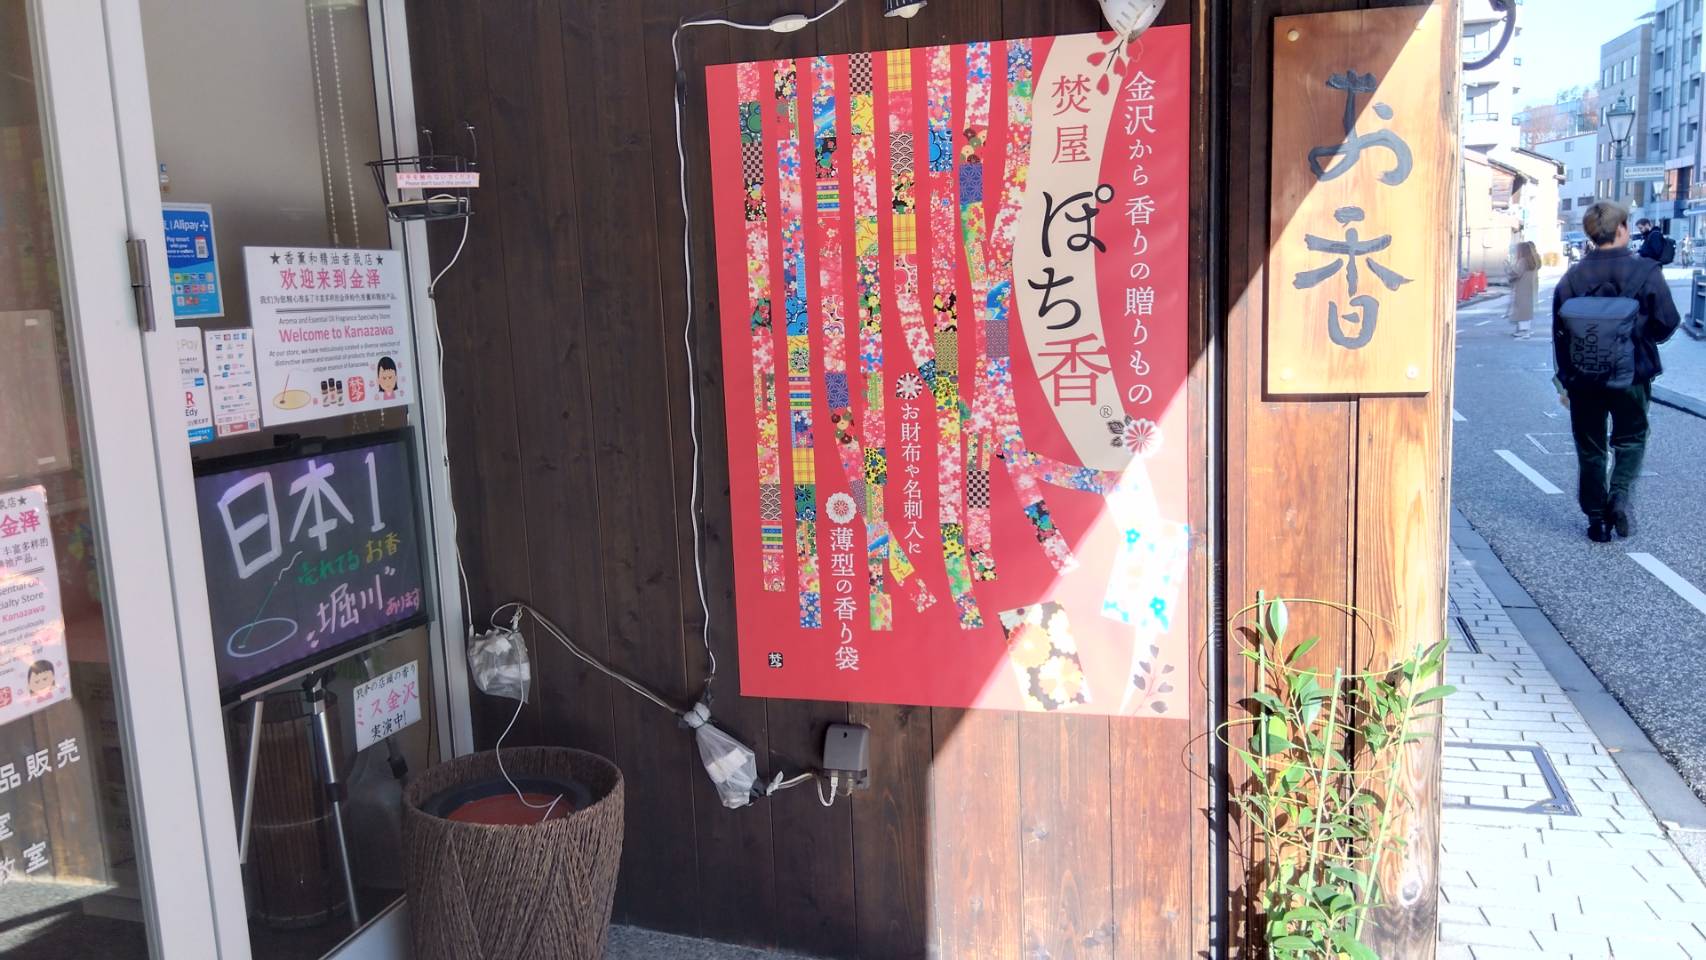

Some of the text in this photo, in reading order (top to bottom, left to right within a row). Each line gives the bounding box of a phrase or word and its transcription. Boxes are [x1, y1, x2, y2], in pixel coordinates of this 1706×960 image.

[1293, 69, 1414, 350] お香
[1027, 74, 1115, 407] 焚屋 ぽち香
[1123, 70, 1156, 405] 金沢から香りの贈りもの
[280, 268, 381, 290] 欢迎来到金泽
[278, 324, 394, 342] Welcome to Kanazawa
[1585, 323, 1599, 371] NORTH
[185, 408, 198, 417] Edy
[900, 402, 924, 555] お財布や名刺入に
[0, 509, 40, 538] 金泽
[217, 451, 386, 580] 日本1
[2, 605, 46, 623] Kanazawa
[21, 591, 44, 604] Store
[829, 527, 860, 671] 薄型の香り袋
[356, 681, 419, 726] ミス金沢
[0, 737, 81, 794] 品販売
